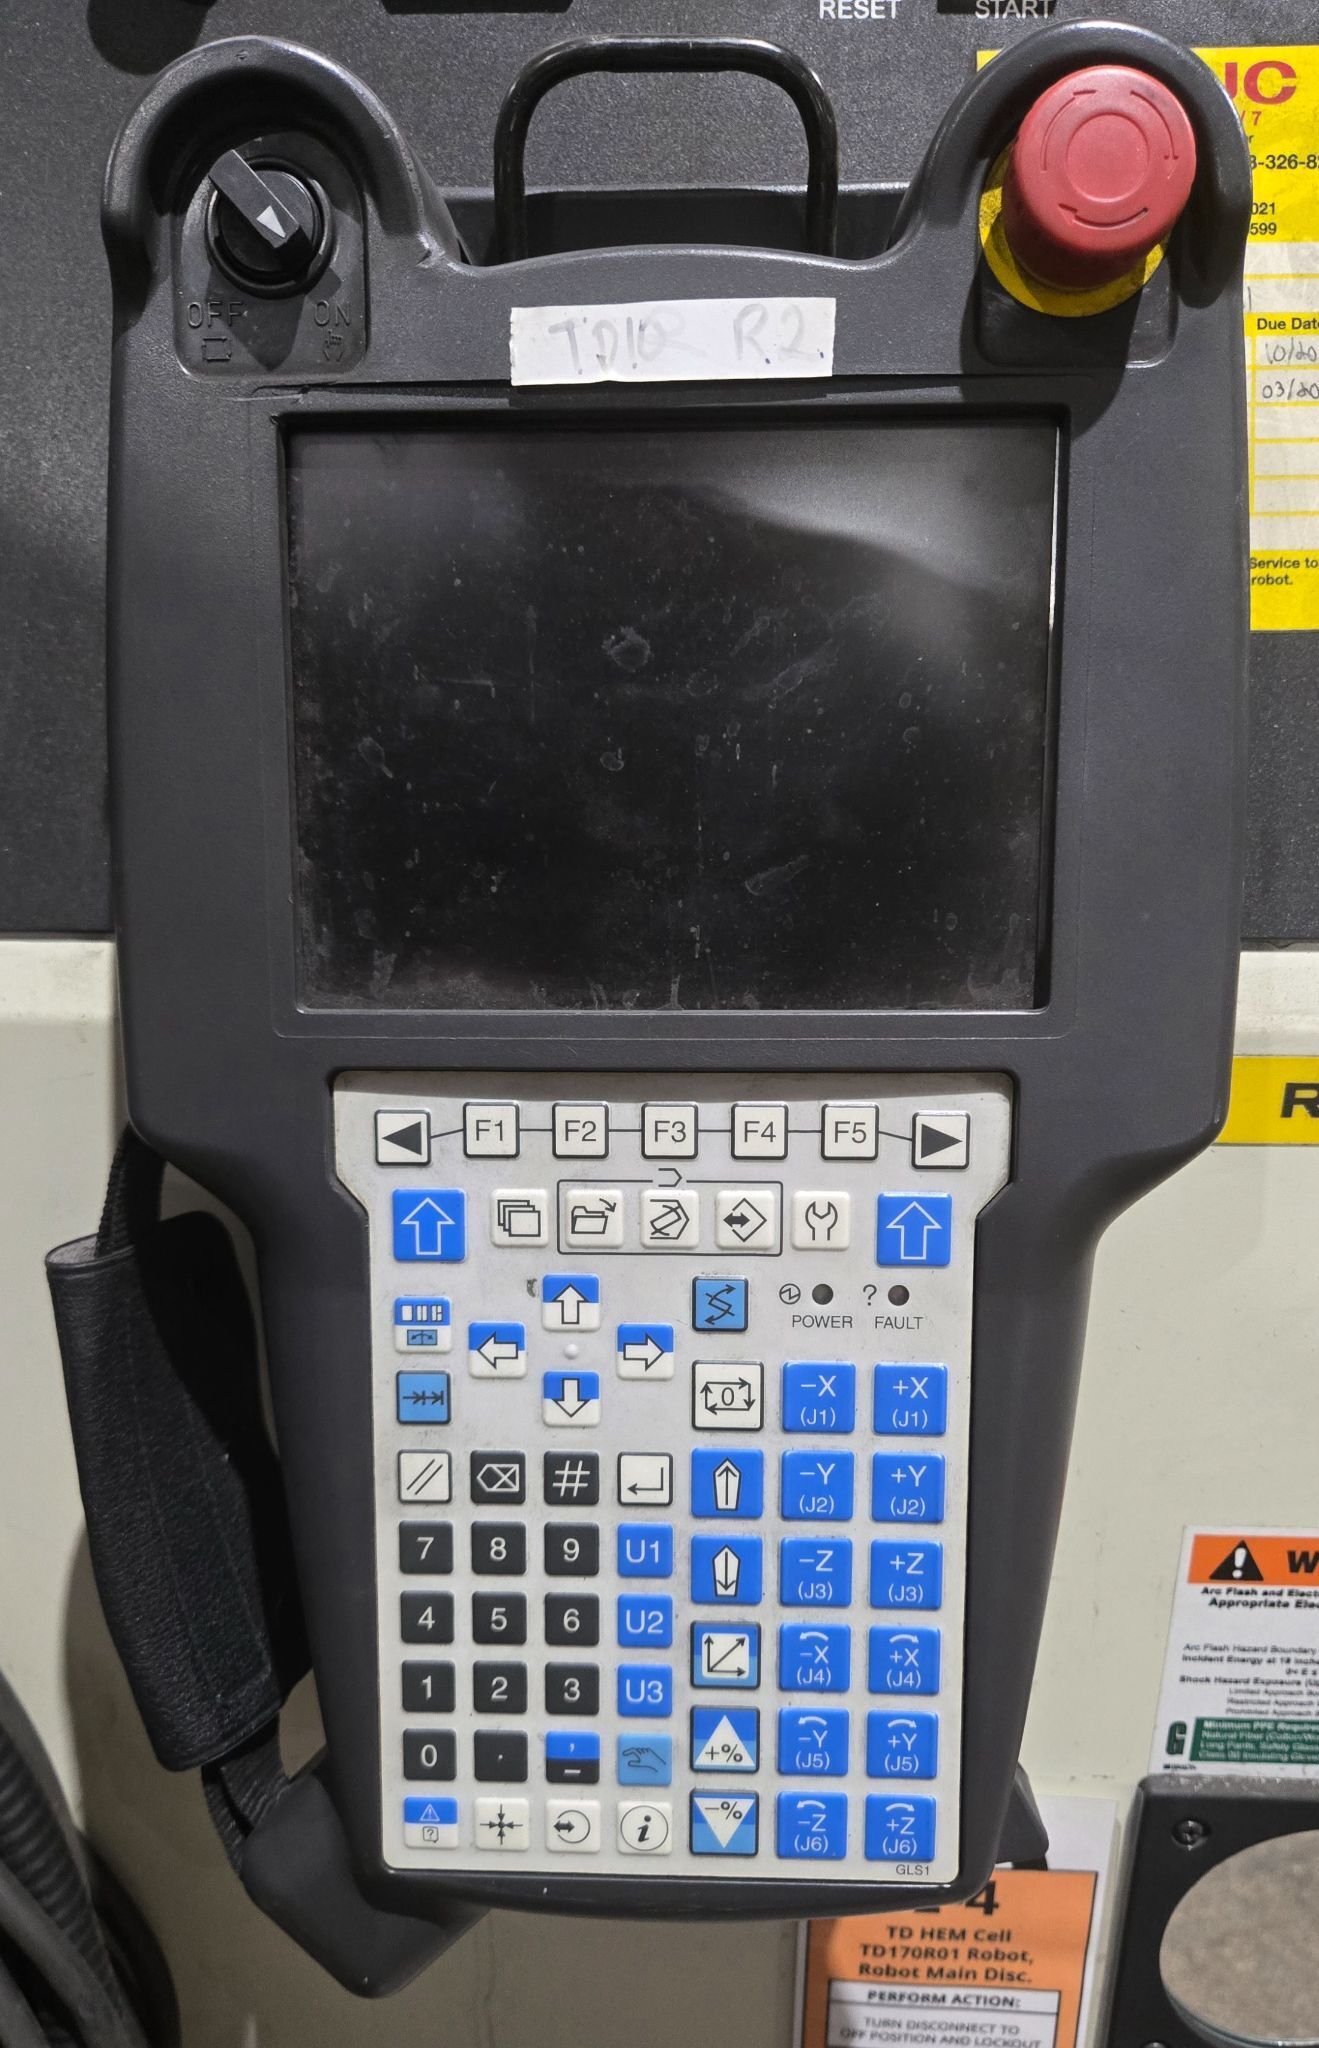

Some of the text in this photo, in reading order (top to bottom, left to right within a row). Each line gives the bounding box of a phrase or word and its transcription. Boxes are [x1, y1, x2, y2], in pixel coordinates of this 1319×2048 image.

[819, 0, 898, 19] RESET
[975, 0, 1049, 19] START
[187, 302, 244, 327] OFF
[313, 300, 352, 326] ON
[1257, 318, 1286, 330] Due
[1249, 557, 1318, 569] Service to
[1251, 573, 1293, 586] robot.
[1281, 1083, 1319, 1118] R
[475, 1120, 505, 1141] F1
[564, 1121, 597, 1142] F2
[653, 1121, 687, 1142] F3
[743, 1121, 777, 1143] F4
[834, 1121, 868, 1143] F5
[792, 1315, 853, 1328] POWER
[874, 1316, 924, 1329] FAULT
[801, 1375, 836, 1397] -X
[893, 1377, 928, 1399] +X
[800, 1407, 836, 1427] (J1)
[892, 1408, 928, 1429] (J1)
[800, 1463, 836, 1485] -Y
[891, 1465, 927, 1487] +Y
[799, 1495, 835, 1514] (J2)
[890, 1497, 926, 1516] (J2)
[416, 1536, 434, 1560] 7
[490, 1537, 507, 1560] 8
[562, 1538, 580, 1562] 9
[625, 1539, 660, 1563] U1
[799, 1550, 833, 1572] -Z
[889, 1552, 924, 1575] +Z
[1287, 1550, 1319, 1573] W
[798, 1581, 833, 1601] (J3)
[888, 1583, 924, 1604] (J3)
[1201, 1587, 1222, 1595] Arc
[1226, 1587, 1258, 1596] Flash
[1262, 1589, 1284, 1597] and
[1209, 1597, 1290, 1609] Appropriate
[418, 1606, 435, 1631] 4
[491, 1607, 507, 1632] 5
[563, 1608, 580, 1633] 6
[625, 1609, 664, 1634] U2
[799, 1645, 829, 1665] -X
[889, 1648, 919, 1668] +X
[796, 1667, 832, 1686] (J4)
[886, 1669, 921, 1689] (J4)
[421, 1675, 432, 1700] 1
[491, 1676, 508, 1701] 2
[563, 1677, 580, 1702] 3
[625, 1679, 664, 1703] U3
[798, 1730, 828, 1749] -Y
[888, 1733, 918, 1752] +Y
[420, 1744, 438, 1767] 0
[704, 1743, 744, 1764] +%
[795, 1751, 830, 1770] (J5)
[884, 1755, 920, 1774] (J5)
[798, 1814, 827, 1832] -Z
[886, 1817, 915, 1836] +Z
[794, 1835, 829, 1853] (J6)
[882, 1837, 918, 1856] (J6)
[895, 1864, 930, 1876] GLS1
[887, 1926, 1012, 1943] TD HEM Cell
[860, 1944, 1034, 1965] TD170R01 Robot,
[859, 1964, 1032, 1983] Robot Main Disc.
[867, 1989, 1021, 2008] PERFORM ACTION:
[864, 2017, 1021, 2036] TURN DISCONNECT TO
[840, 2028, 866, 2041] OFF
[871, 2030, 937, 2044] POSITION
[941, 2034, 971, 2047] AND
